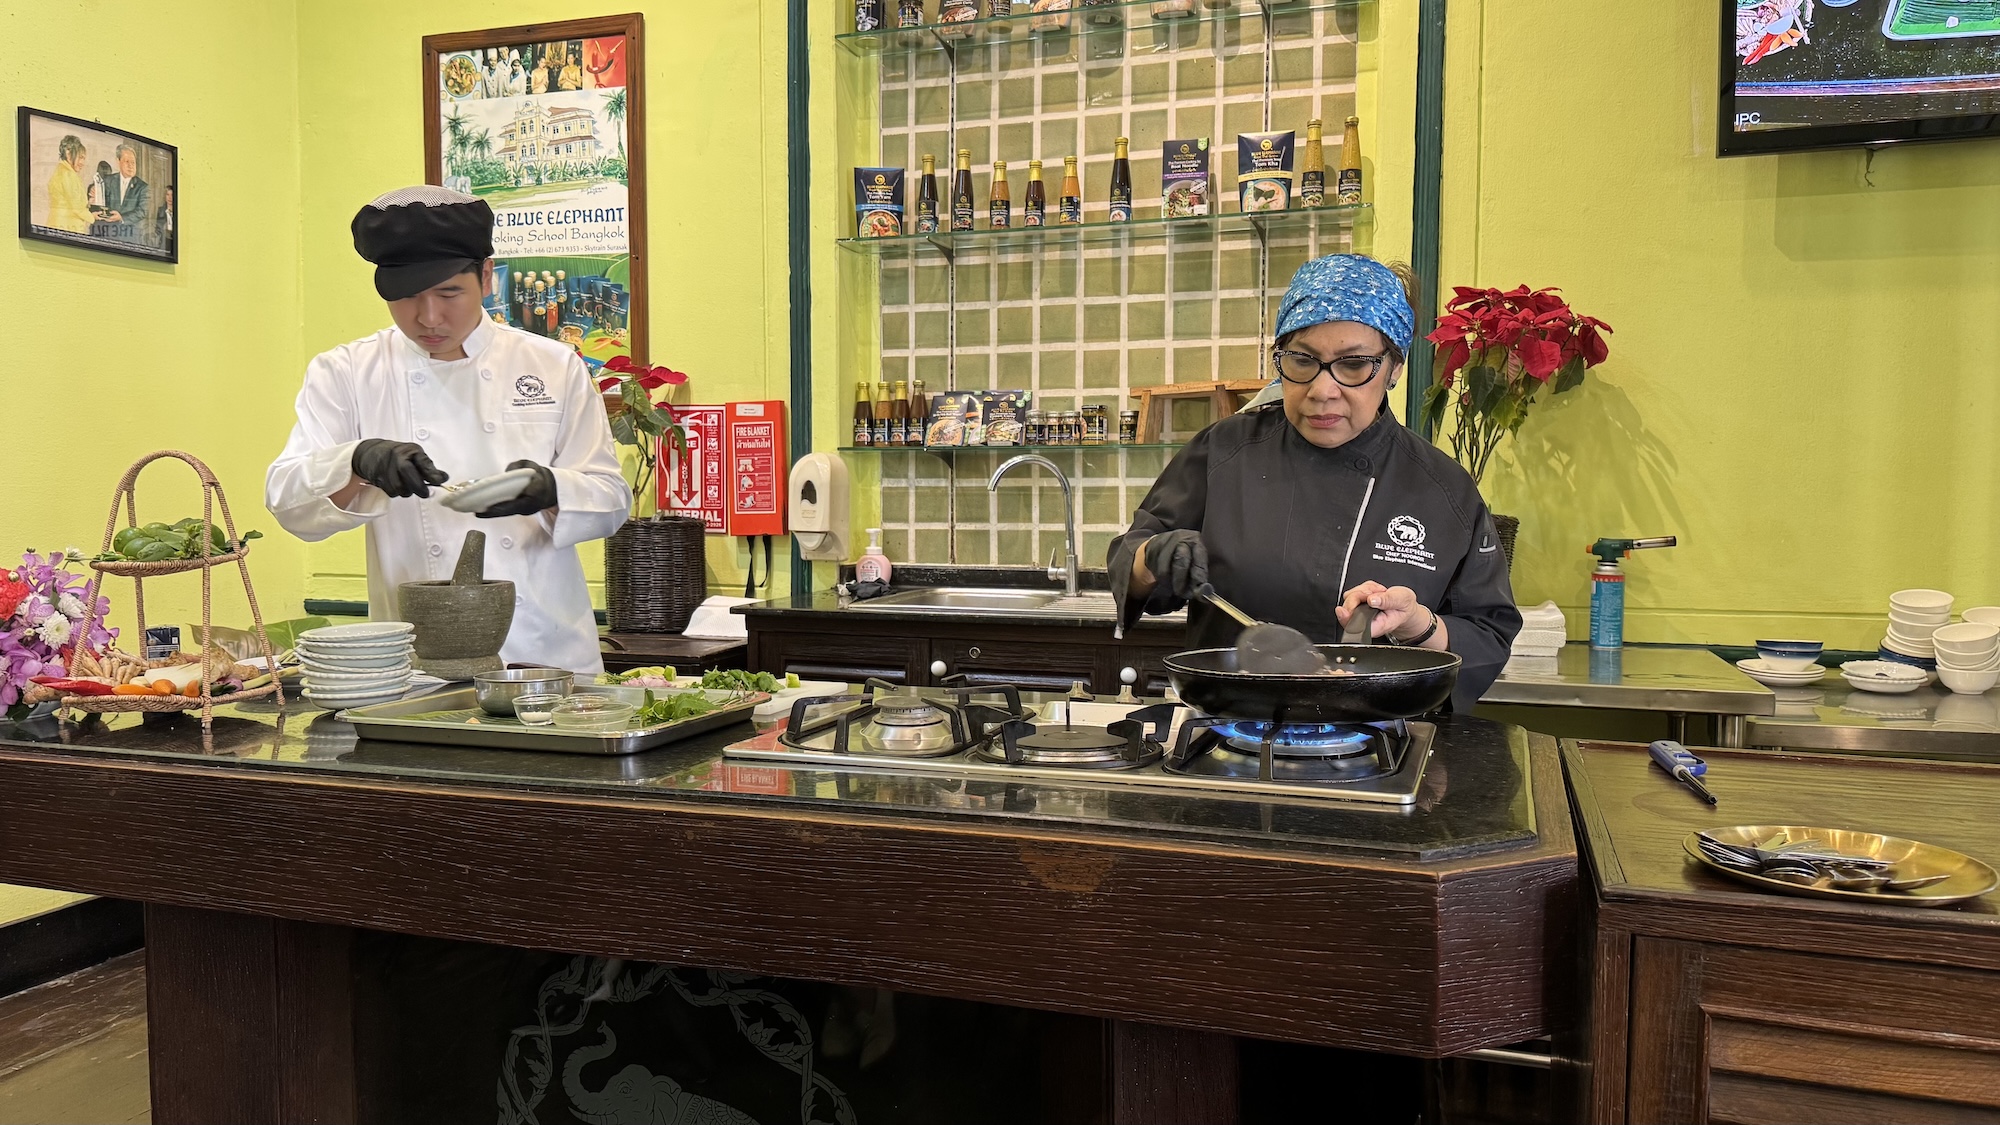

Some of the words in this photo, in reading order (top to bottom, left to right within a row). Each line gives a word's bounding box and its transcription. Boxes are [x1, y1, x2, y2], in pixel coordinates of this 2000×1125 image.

[507, 210, 543, 227] BLUE
[547, 207, 625, 225] ELEPHANT
[527, 227, 567, 242] School
[571, 225, 625, 242] Bangkok
[736, 426, 747, 437] FIRE
[747, 426, 771, 436] BLANKET
[674, 440, 697, 448] FRE
[1375, 543, 1394, 551] BLUE
[1396, 546, 1435, 560] ELEPHANT
